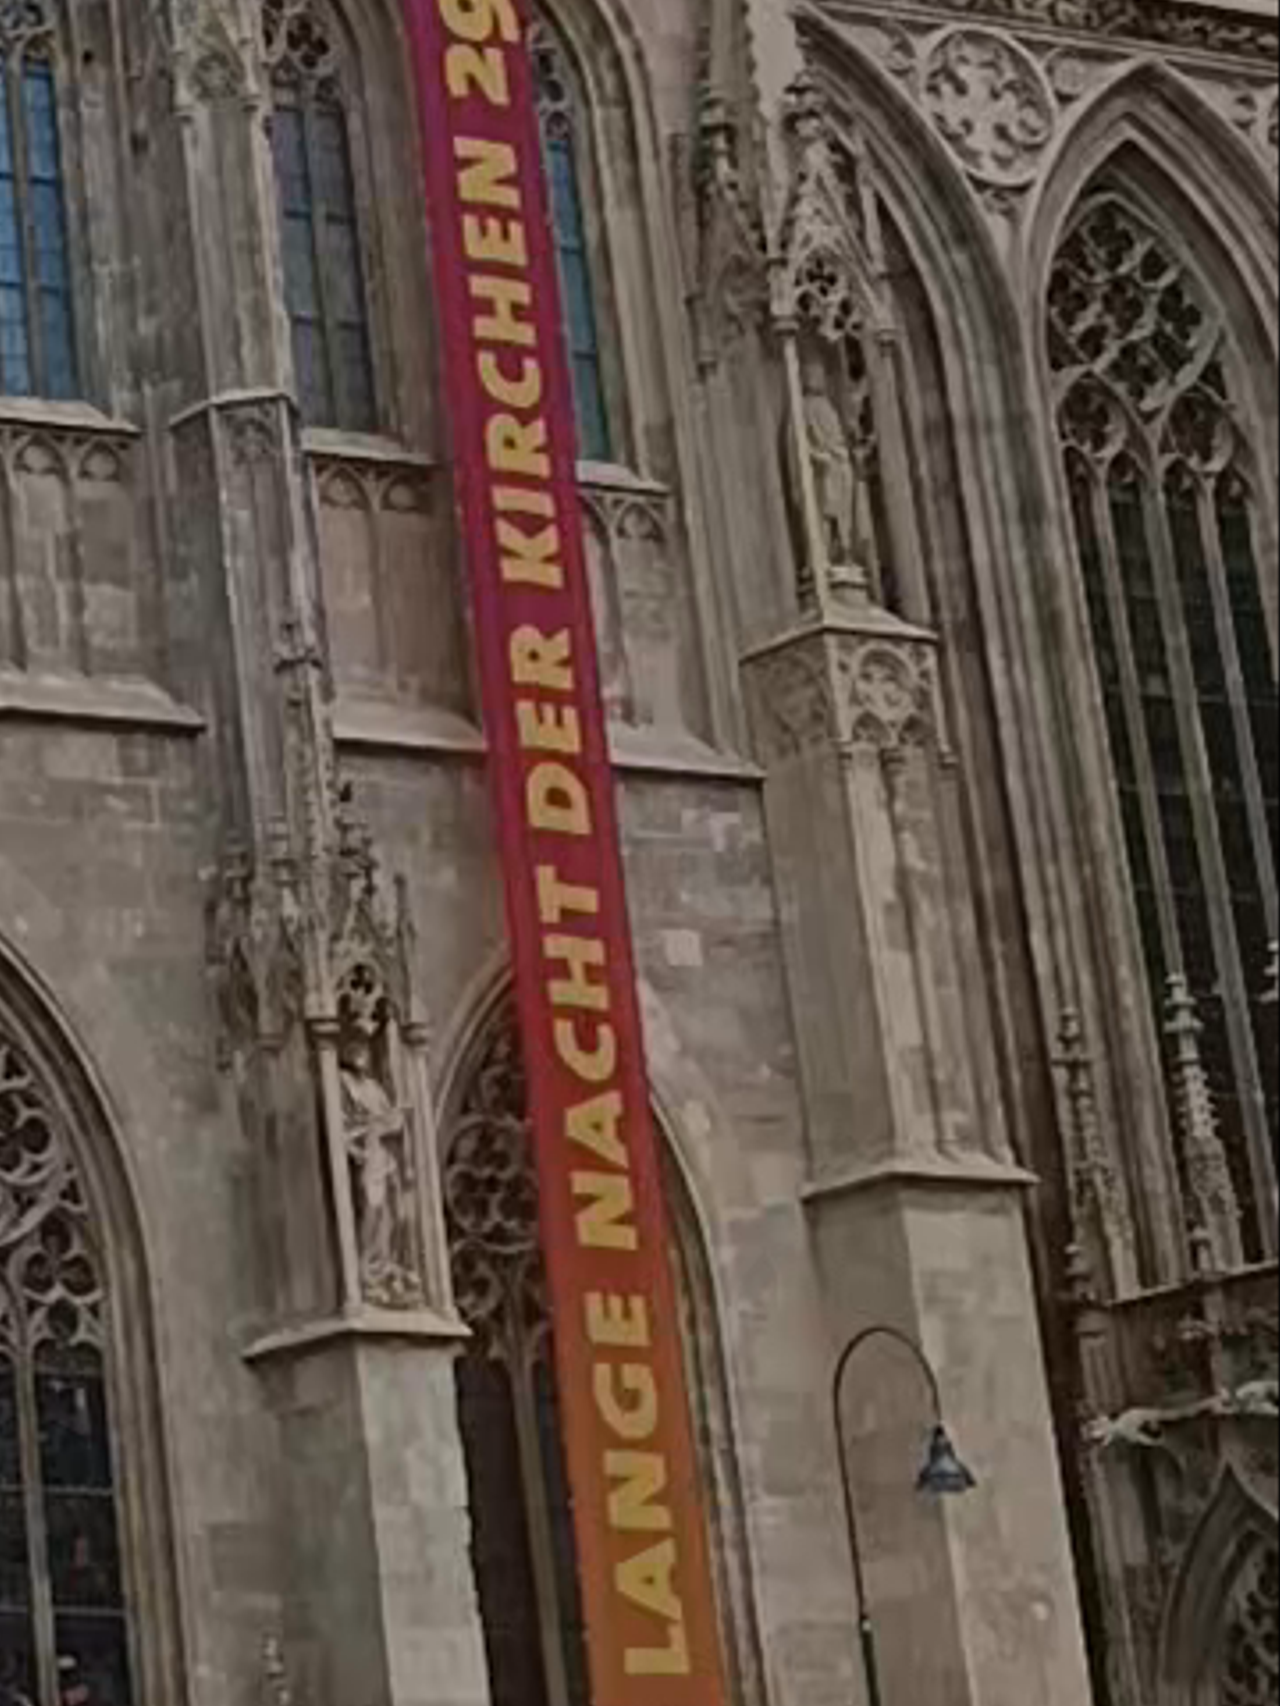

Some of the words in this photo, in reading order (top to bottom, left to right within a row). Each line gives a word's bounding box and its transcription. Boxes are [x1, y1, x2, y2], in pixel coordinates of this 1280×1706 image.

[453, 136, 563, 588] KIRCHEN
[509, 625, 591, 835] DER
[536, 865, 638, 1252] NACHT
[585, 1291, 692, 1676] LANGE
